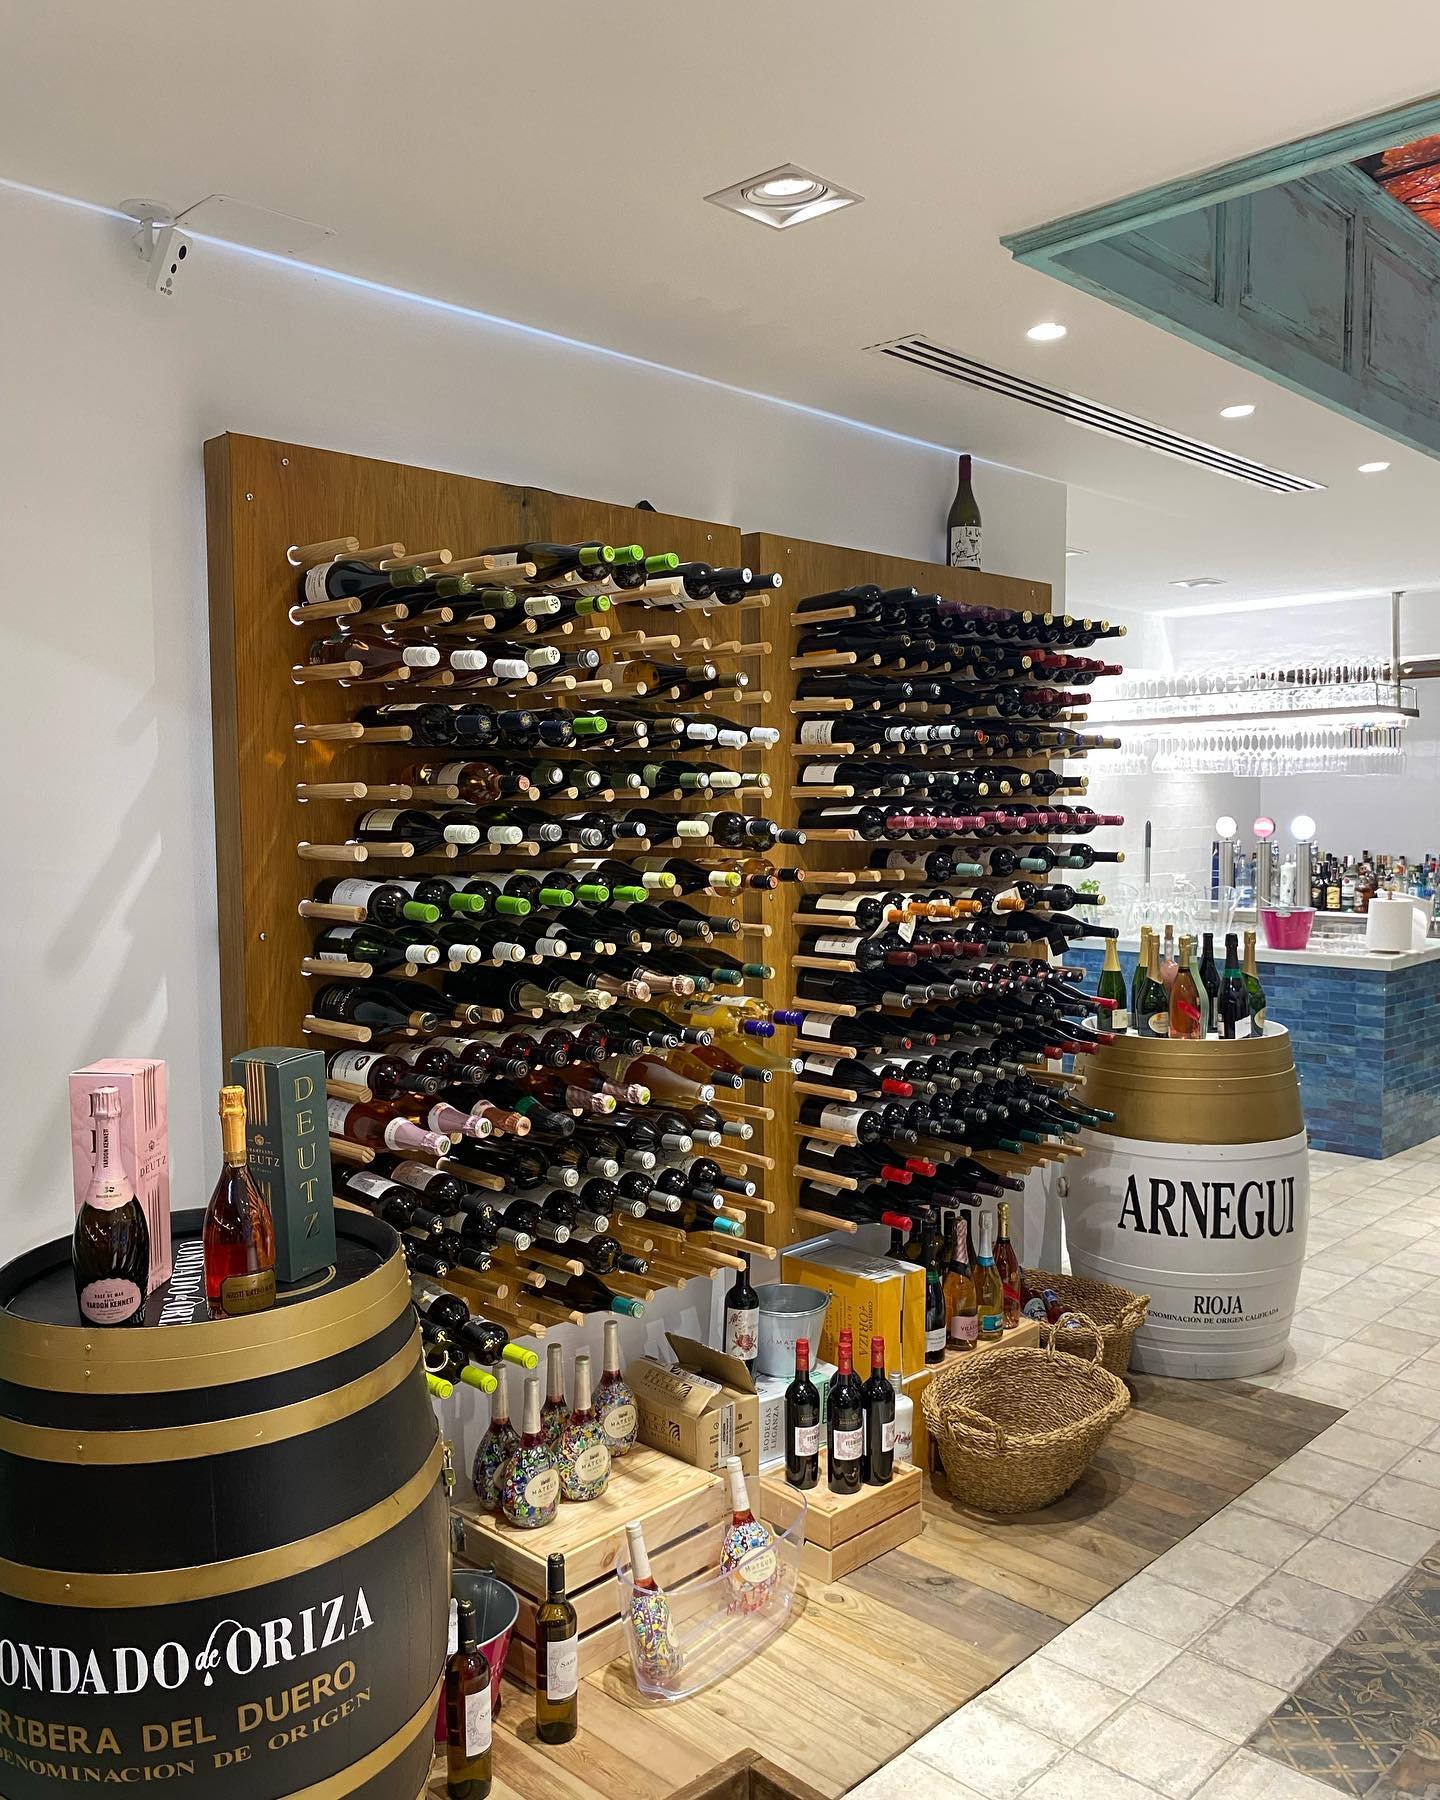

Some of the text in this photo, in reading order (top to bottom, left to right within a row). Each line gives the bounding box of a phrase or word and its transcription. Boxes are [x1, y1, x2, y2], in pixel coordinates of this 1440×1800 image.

[140, 1155, 168, 1177] DEUTZ
[248, 1154, 280, 1168] EUTZ
[293, 1075, 320, 1241] DEUTZ
[1117, 1173, 1295, 1240] ARNEGUI
[167, 1240, 205, 1295] CONDADO
[109, 1296, 134, 1308] KENNETT
[1193, 1295, 1243, 1315] RIOJA
[1216, 1316, 1244, 1324] ORIGEN
[1245, 1307, 1279, 1322] CALIFICADA
[763, 1407, 771, 1452] BODEGAS
[770, 1405, 779, 1449] LEGANZA
[0, 1638, 189, 1695] ONDADO
[225, 1586, 375, 1675] ORIZA
[0, 1658, 357, 1756] RIBERA DEL DUERO
[213, 1744, 252, 1769] DE
[268, 1686, 372, 1751] ORIGEN
